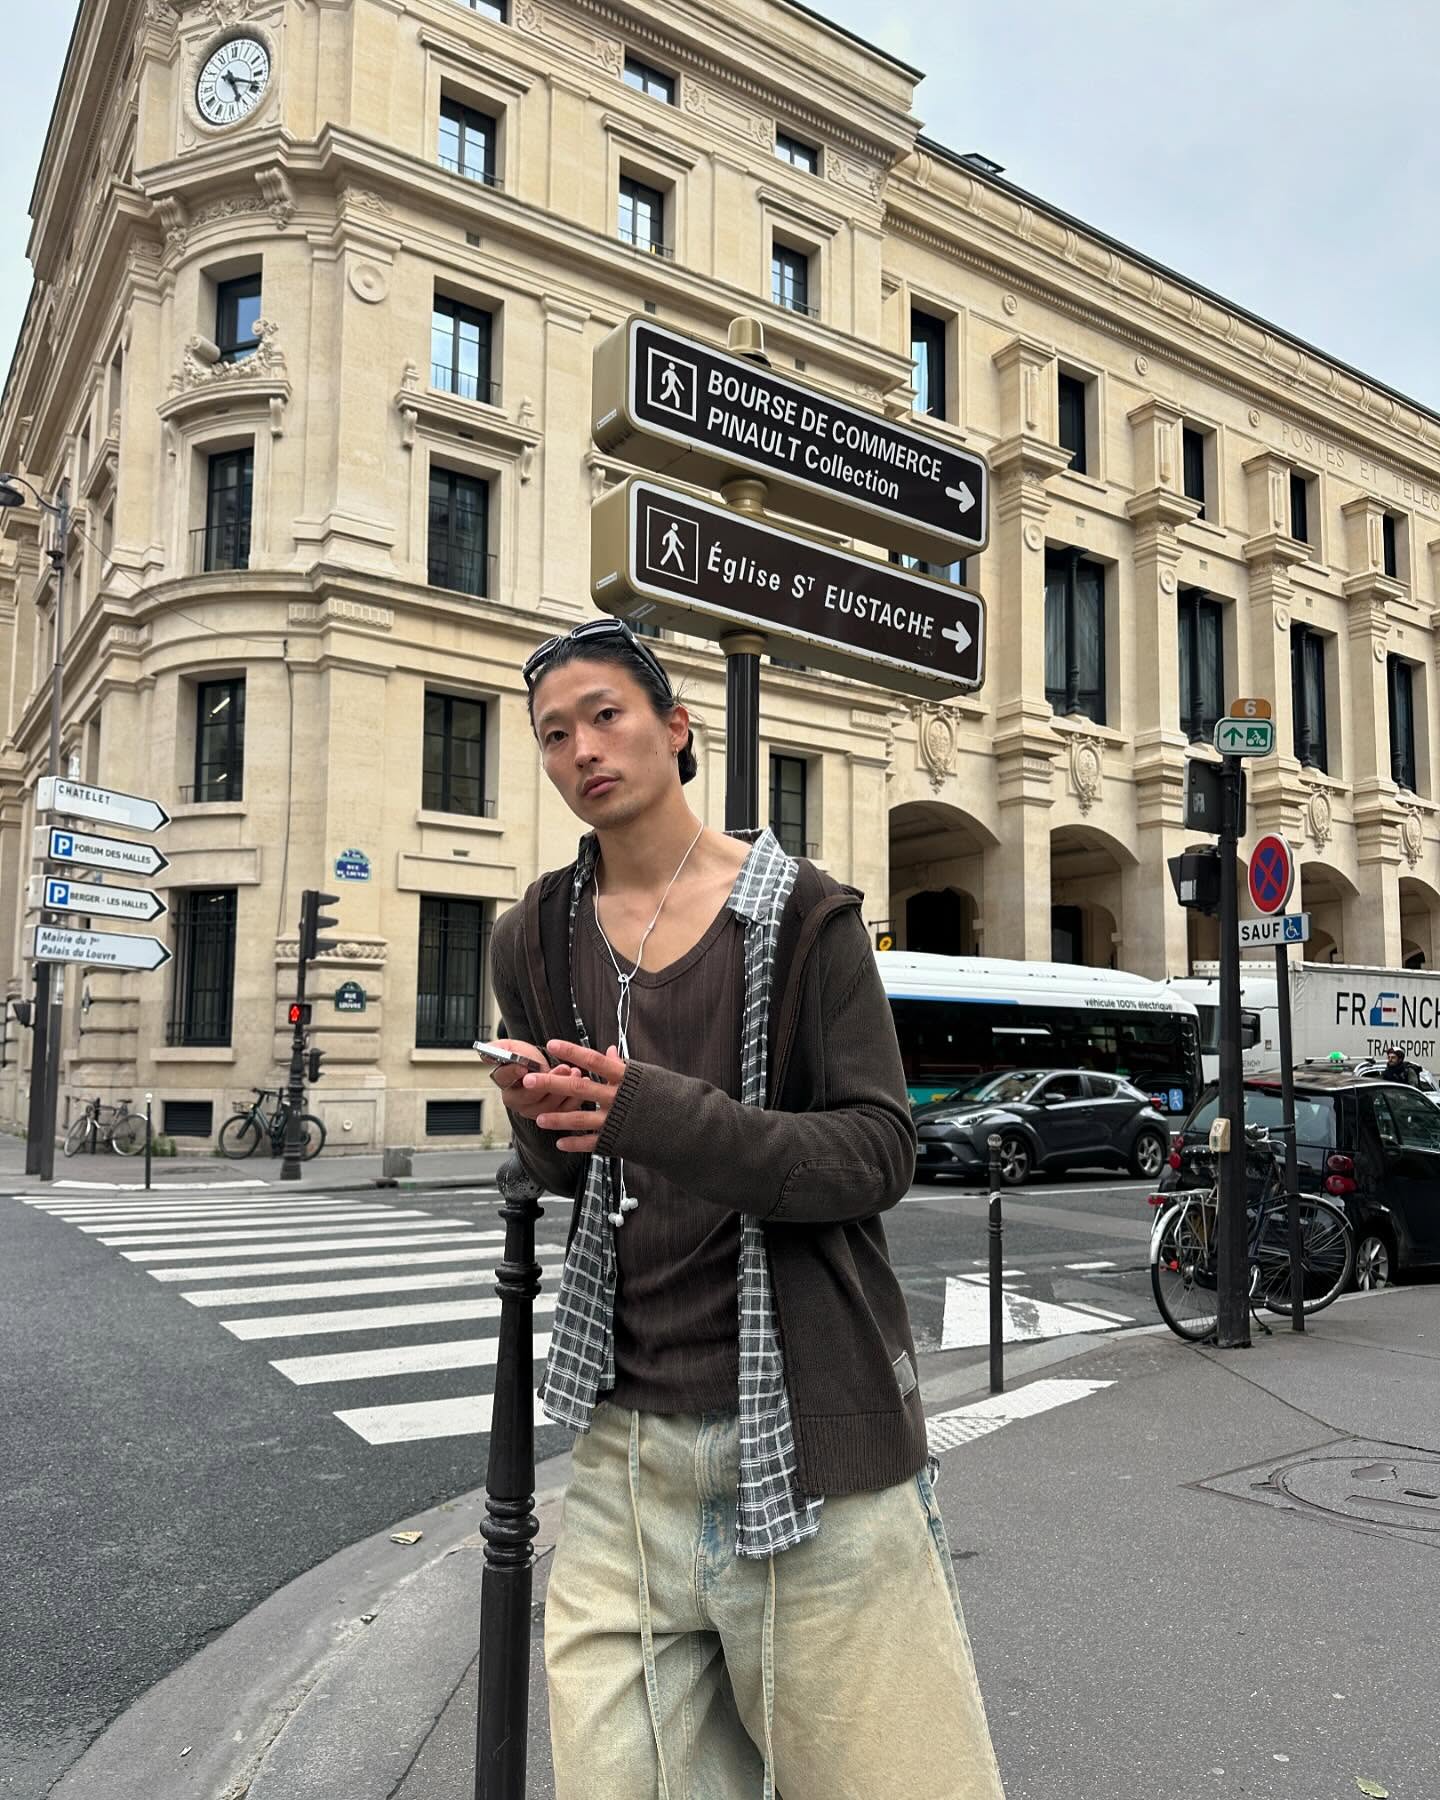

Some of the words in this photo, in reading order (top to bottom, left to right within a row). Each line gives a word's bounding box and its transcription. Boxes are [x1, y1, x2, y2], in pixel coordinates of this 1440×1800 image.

[708, 369, 797, 426] BOURSE
[800, 406, 828, 438] DE
[832, 420, 942, 482] COMMERCE
[707, 406, 801, 462] PINAULT
[804, 445, 899, 501] Collection
[1280, 423, 1345, 468] POSTES
[1360, 460, 1380, 484] ET
[707, 541, 781, 591] Église
[824, 584, 934, 639] EUSTACHE
[1244, 700, 1257, 716] 6
[58, 785, 110, 805] CHATELET
[58, 837, 70, 854] P
[74, 843, 104, 856] FORUM
[105, 848, 121, 859] DES
[122, 851, 151, 864] HALLES
[53, 886, 66, 902] P
[69, 892, 100, 903] BERGER
[106, 896, 121, 906] LES
[121, 898, 149, 910] HALLES
[41, 932, 73, 943] Mairie
[75, 935, 86, 945] du
[1241, 922, 1280, 941] SAUF
[40, 944, 70, 956] Palais
[72, 948, 84, 958] du
[86, 949, 117, 961] Louvre
[1084, 998, 1116, 1008] véhicule
[1117, 999, 1138, 1009] 100%
[1138, 1000, 1173, 1010] électrique
